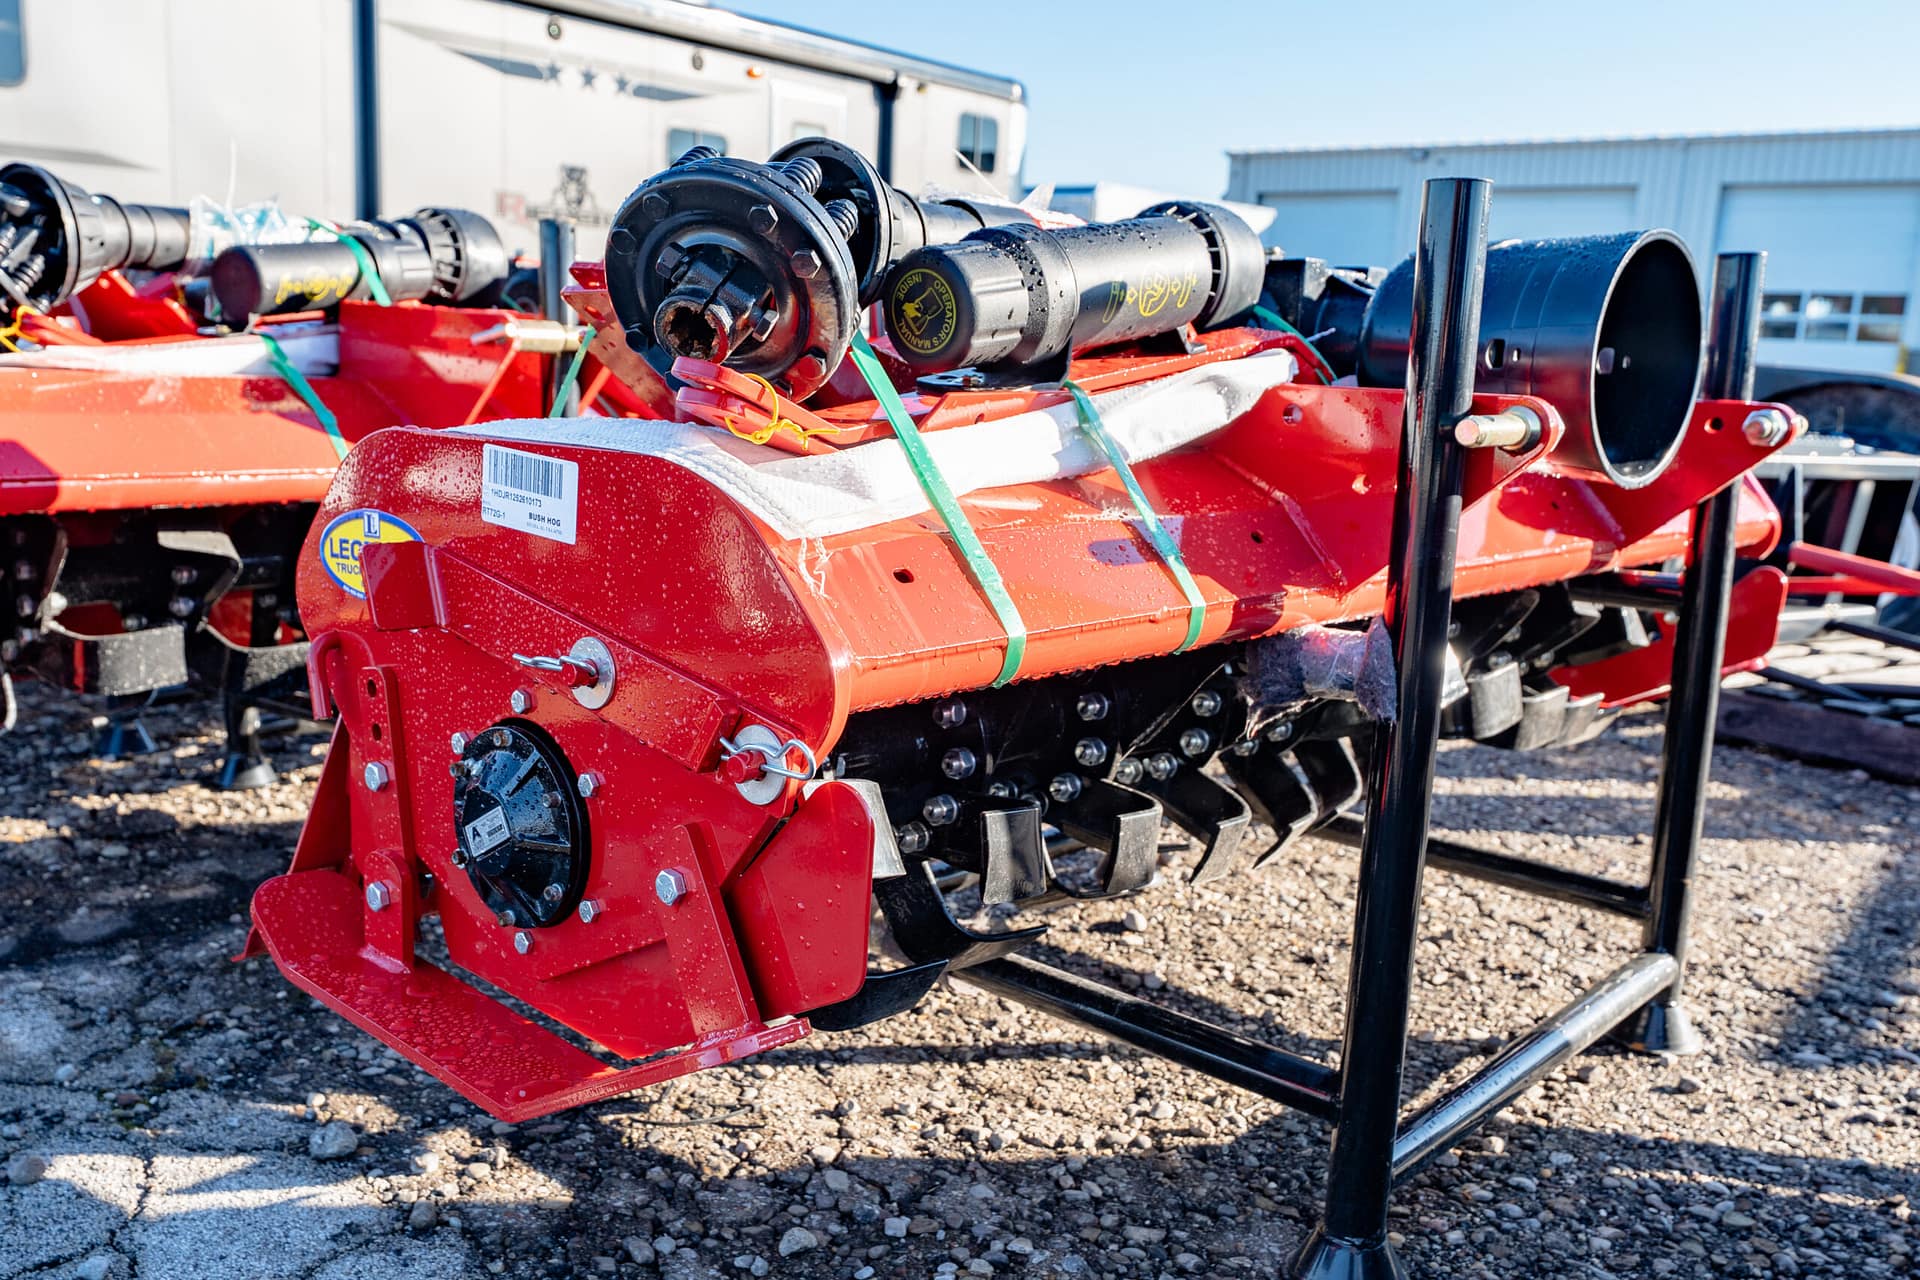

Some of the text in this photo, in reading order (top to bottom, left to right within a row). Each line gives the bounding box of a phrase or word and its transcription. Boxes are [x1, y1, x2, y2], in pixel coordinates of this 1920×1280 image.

[896, 273, 953, 349] OPERATOR'S MANUAL INSIDE
[528, 511, 561, 527] BUSH HOG
[330, 537, 367, 561] LEG
[336, 562, 361, 575] TRUC
